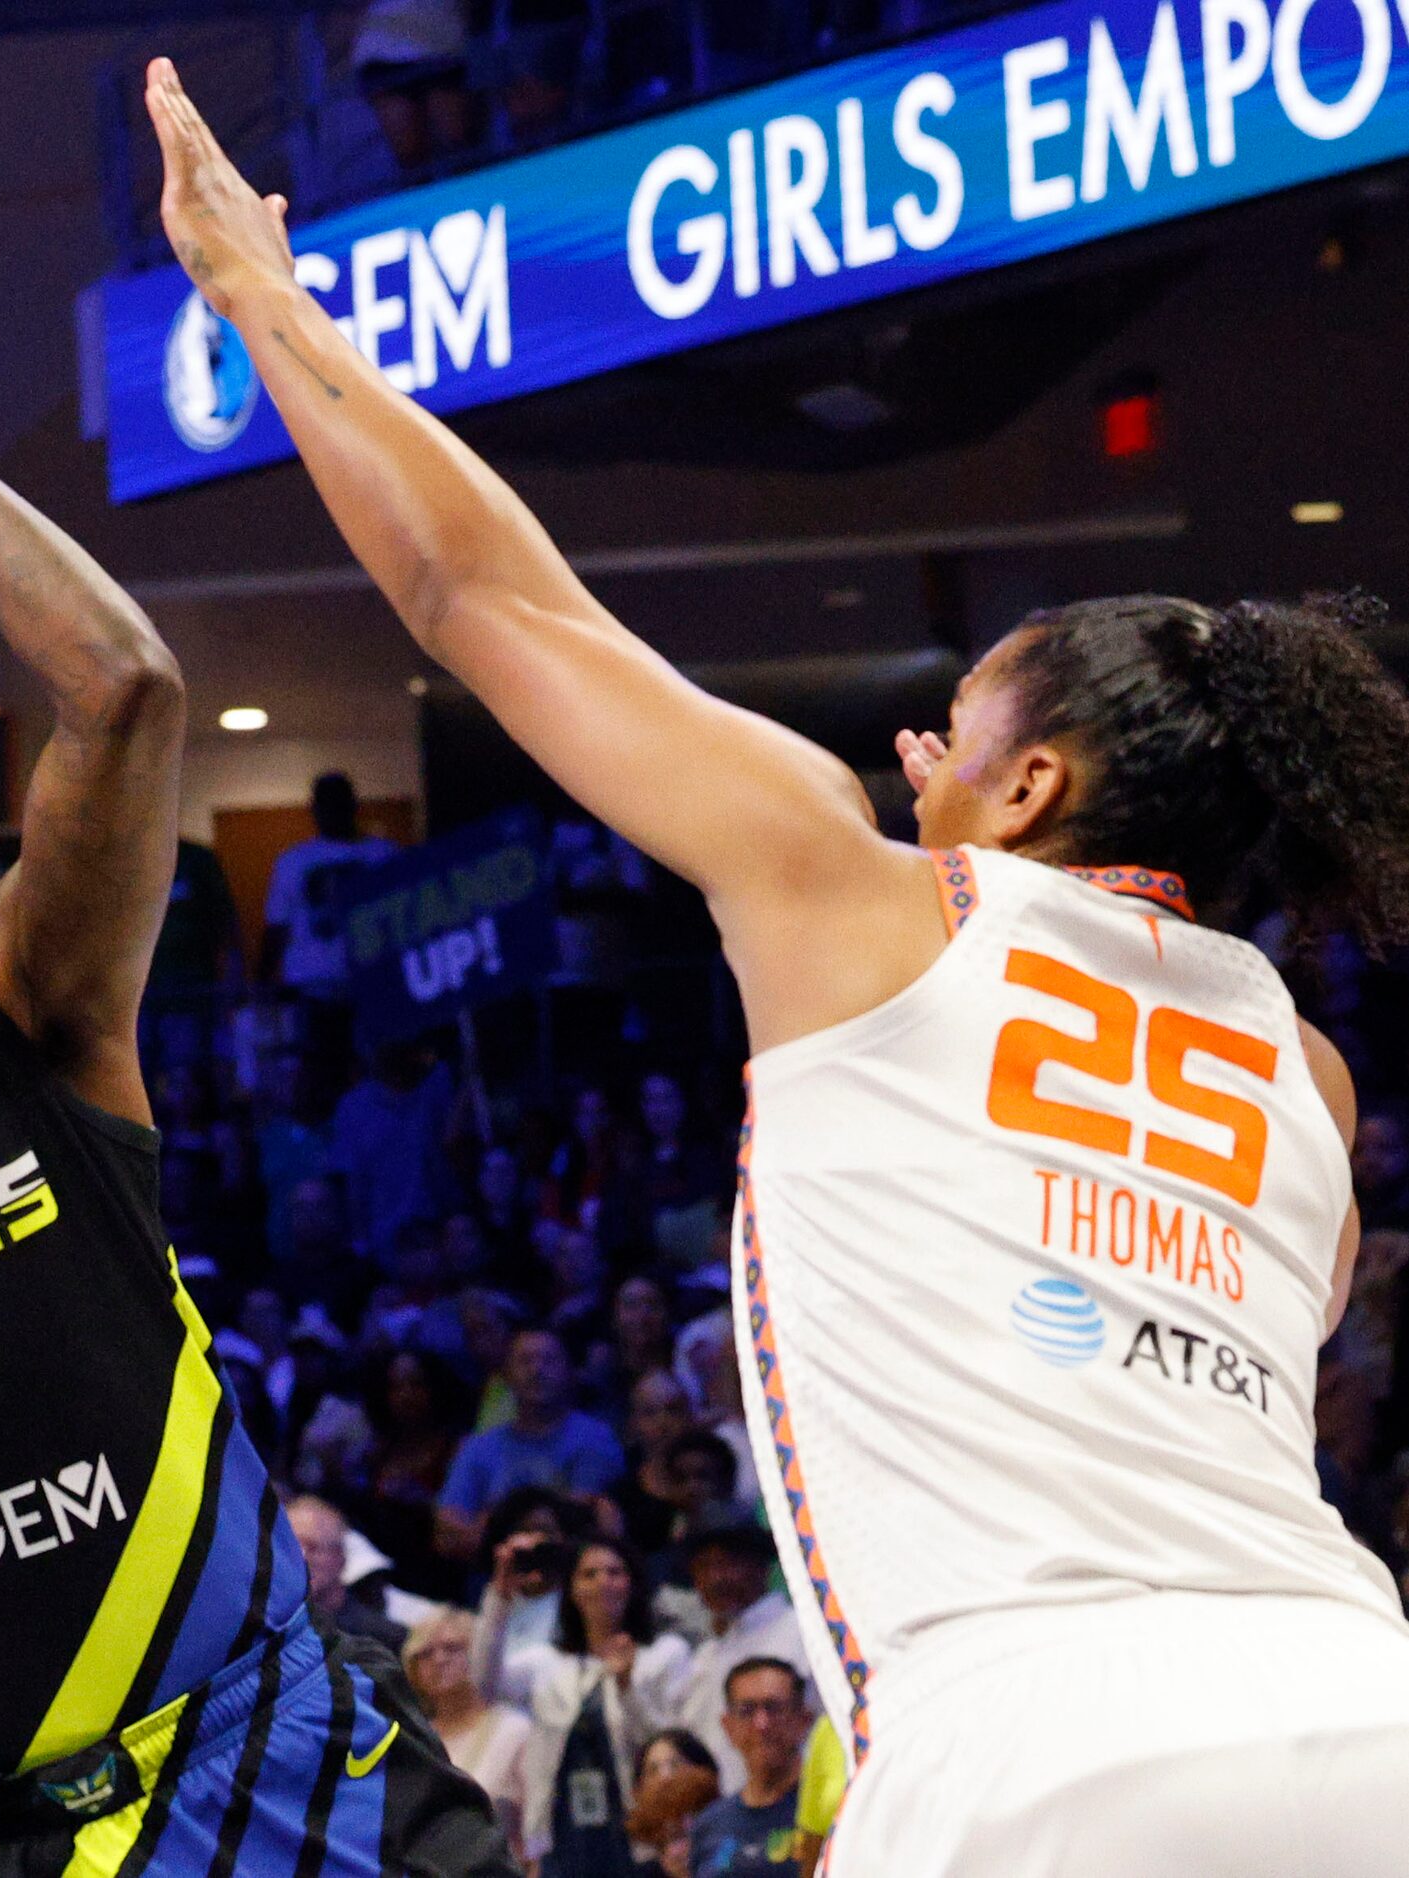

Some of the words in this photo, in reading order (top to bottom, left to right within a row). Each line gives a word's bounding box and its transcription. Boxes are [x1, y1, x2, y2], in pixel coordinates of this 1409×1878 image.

[627, 71, 965, 319] GIRLS
[1002, 0, 1409, 222] EMPO
[400, 916, 504, 1001] UP!
[987, 948, 1279, 1208] 25
[1034, 1169, 1245, 1302] THOMAS
[1123, 1319, 1274, 1414] AT&T
